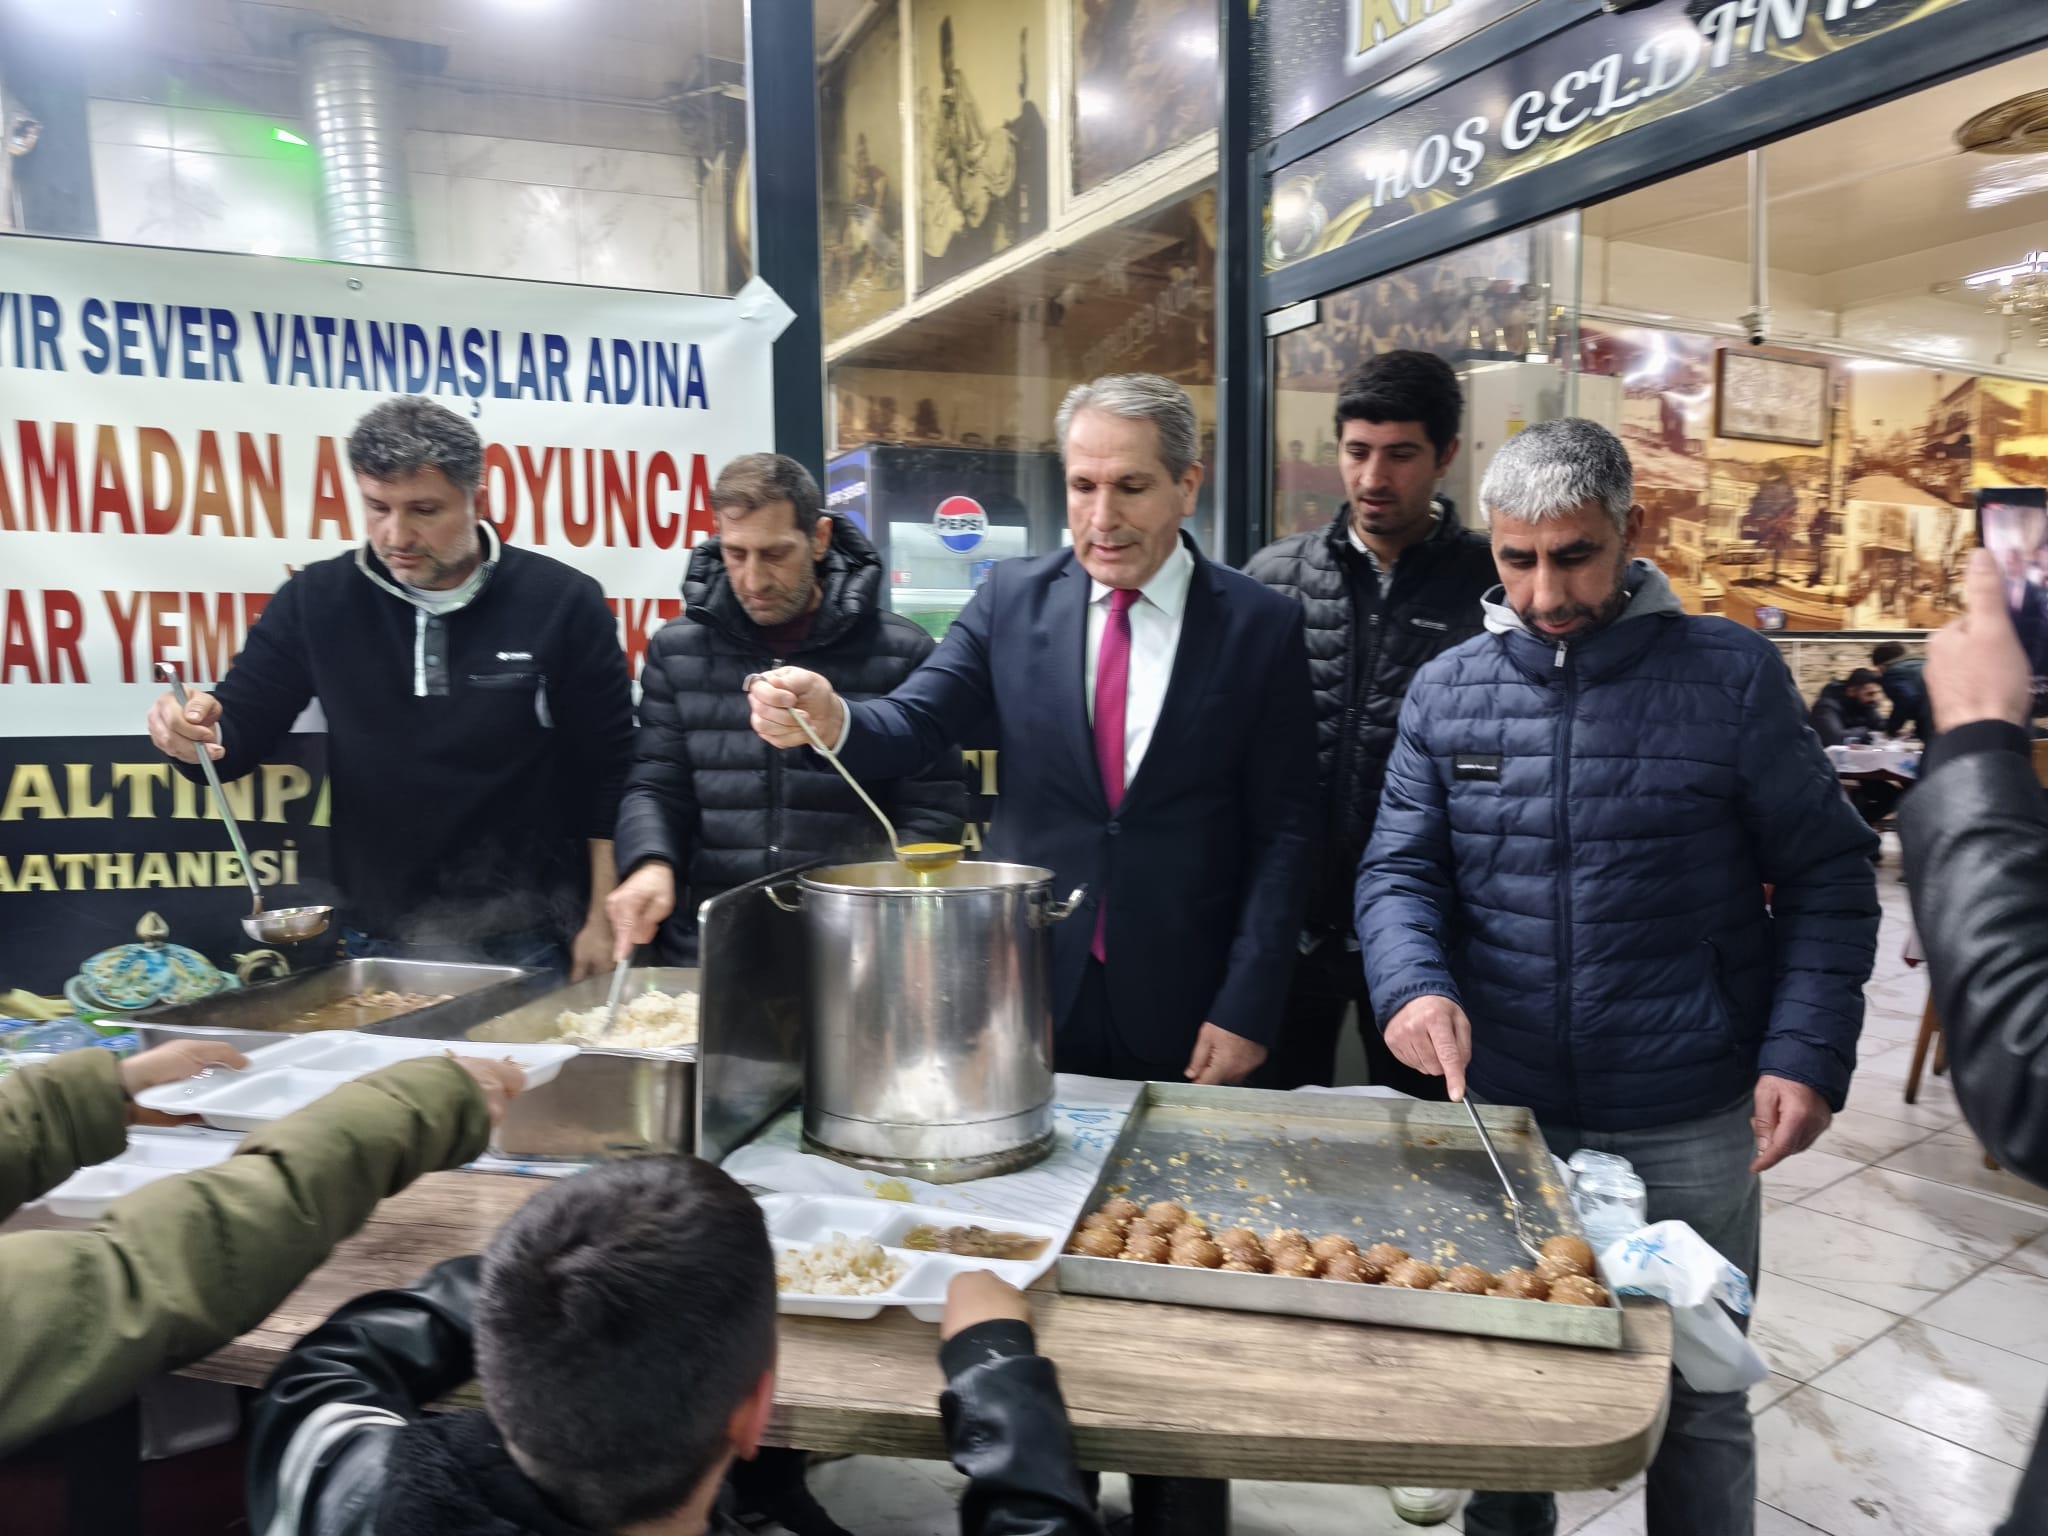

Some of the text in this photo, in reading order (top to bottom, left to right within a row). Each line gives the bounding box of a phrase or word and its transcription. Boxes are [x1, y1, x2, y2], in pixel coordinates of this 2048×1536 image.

[1365, 116, 1489, 207] HOŞ
[0, 292, 710, 418] IR SEVER VATANDAŞLAR ADINA
[308, 436, 355, 541] A
[482, 442, 718, 550] OYUNCA
[938, 517, 984, 531] PEPSI
